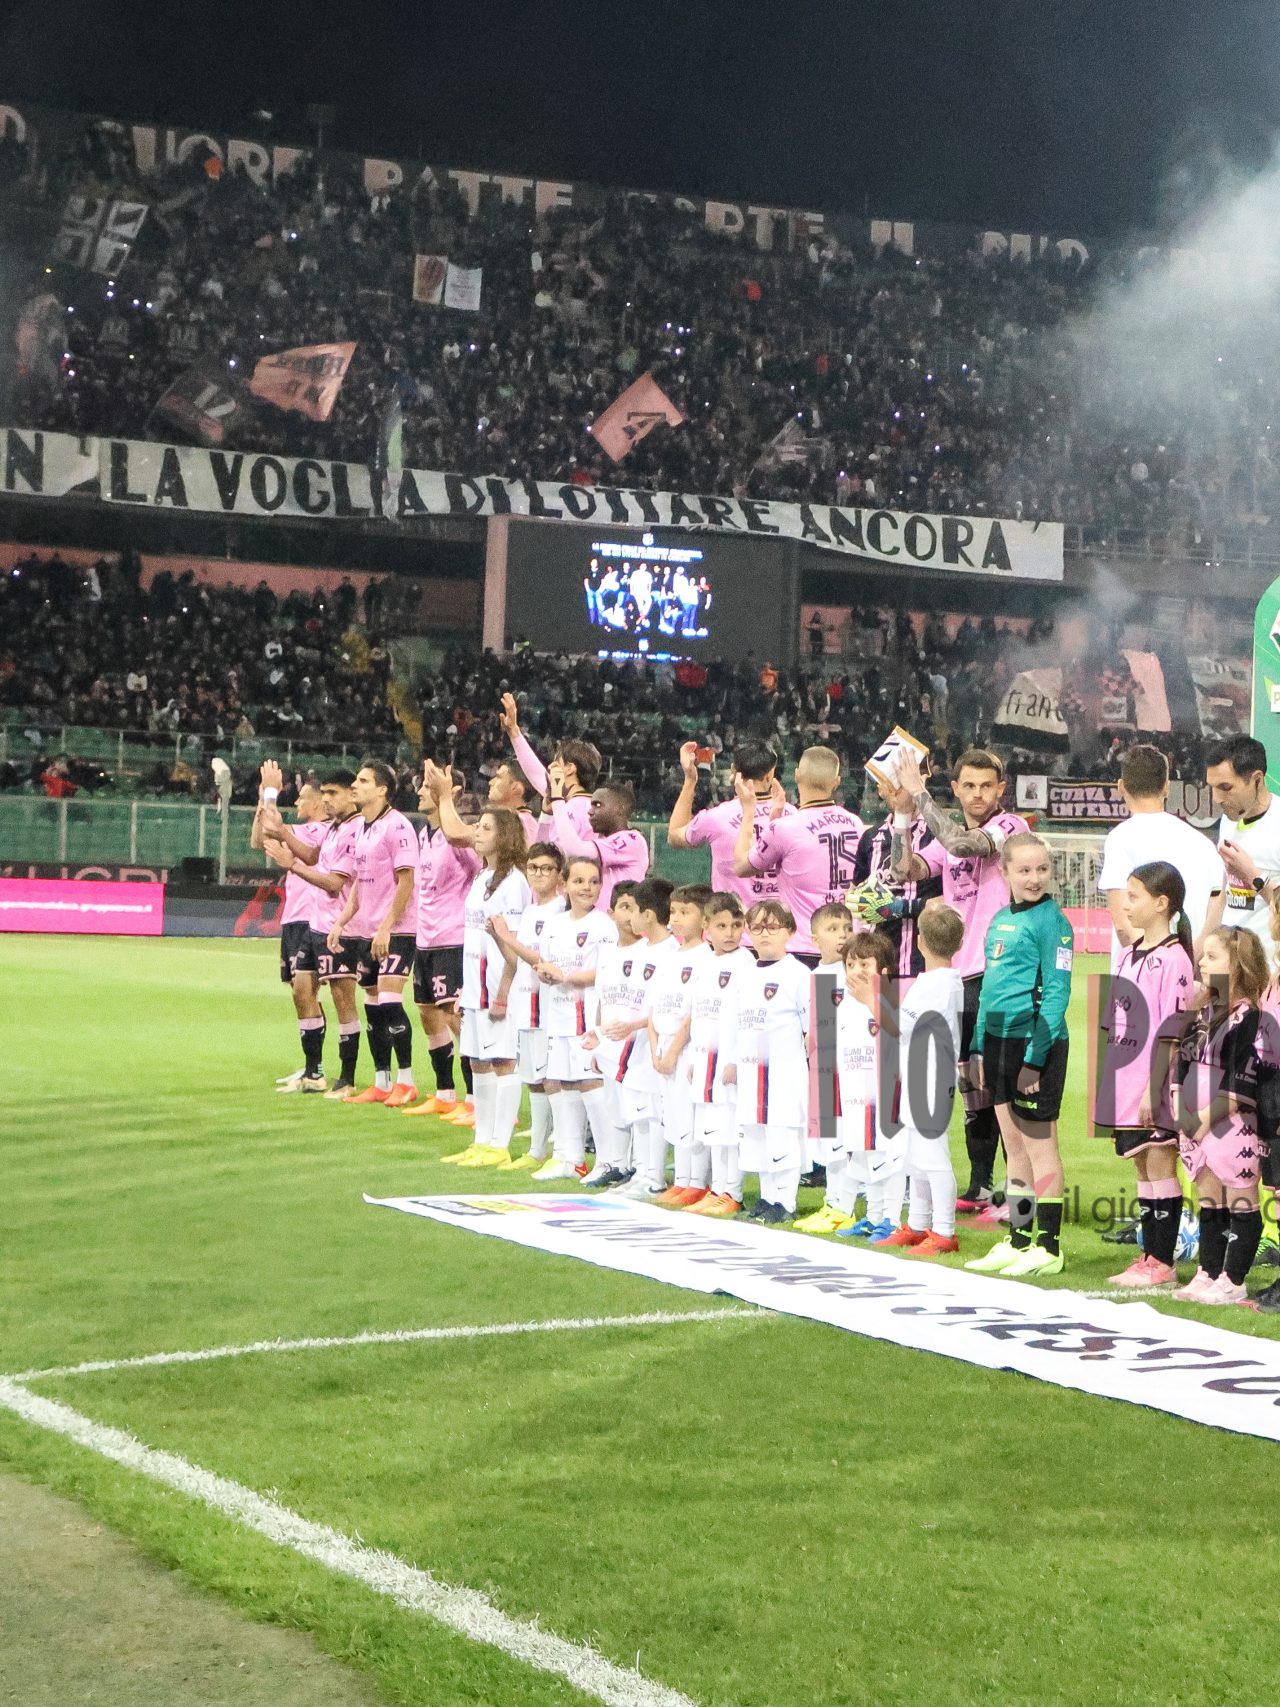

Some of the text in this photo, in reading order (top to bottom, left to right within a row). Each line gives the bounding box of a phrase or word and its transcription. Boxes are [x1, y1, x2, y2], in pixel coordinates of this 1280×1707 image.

[110, 441, 189, 507] LA
[209, 451, 428, 517] VOGLIA
[445, 475, 512, 514] DI
[526, 479, 780, 534] LOTTARE
[800, 500, 1013, 571] ANCORA
